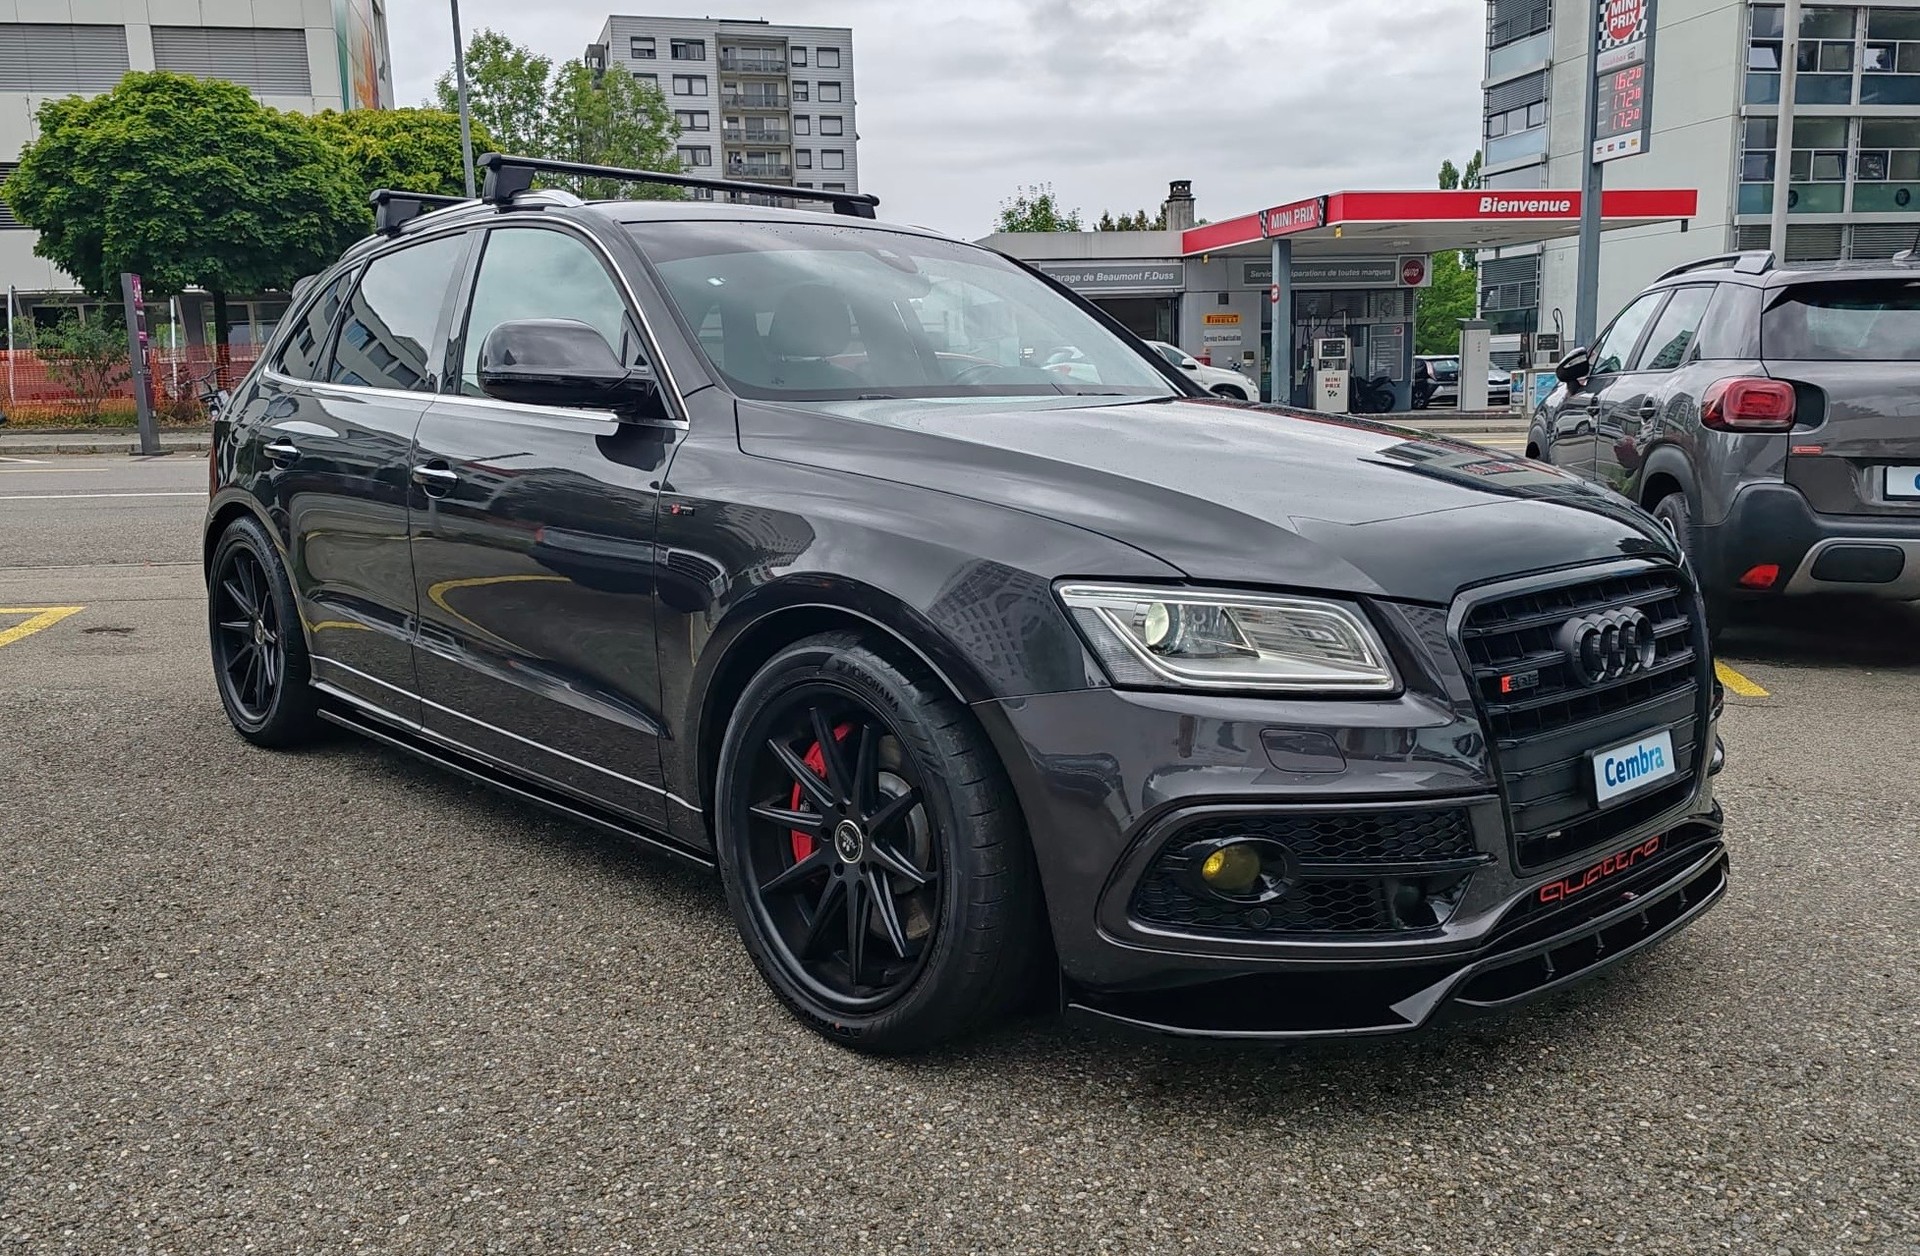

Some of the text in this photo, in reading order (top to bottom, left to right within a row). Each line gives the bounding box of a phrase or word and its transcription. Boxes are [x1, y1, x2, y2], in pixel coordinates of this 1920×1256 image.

[1611, 0, 1637, 17] MINI
[1610, 10, 1637, 32] PRIX
[1479, 197, 1571, 213] Bienvenue
[1271, 204, 1315, 230] MINI PRIX
[1049, 273, 1081, 284] Garage
[1083, 272, 1094, 282] de
[1096, 272, 1142, 282] Beaumont
[1604, 744, 1665, 787] Cembra
[1540, 835, 1660, 902] quattro
